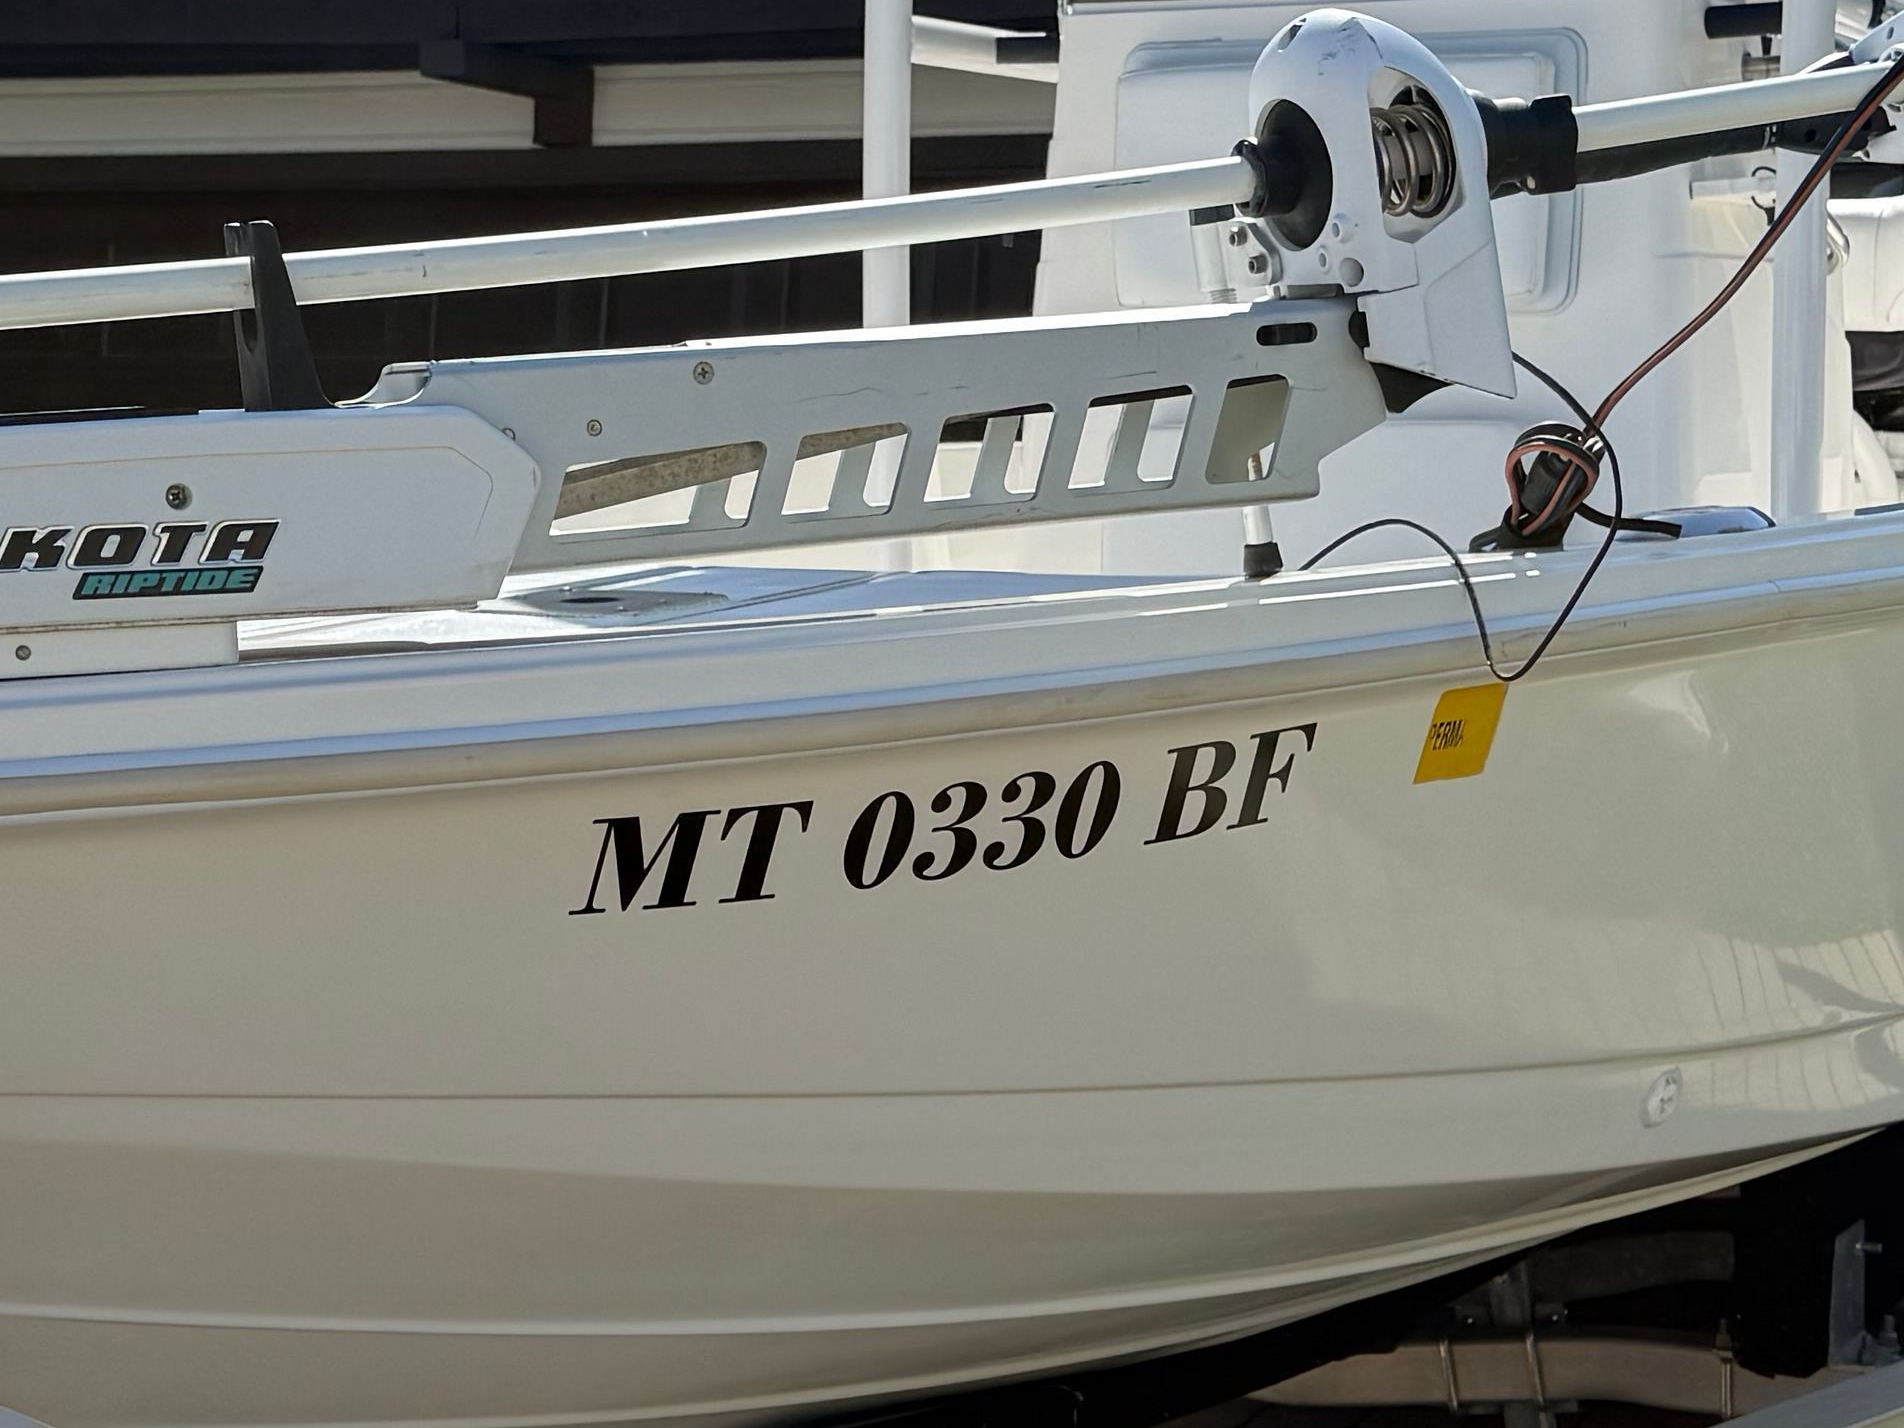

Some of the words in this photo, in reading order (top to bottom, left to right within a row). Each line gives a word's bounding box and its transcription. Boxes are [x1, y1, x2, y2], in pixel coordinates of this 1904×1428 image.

[80, 568, 259, 595] RIPTIDE
[568, 799, 814, 916] MT
[842, 760, 1121, 890] 0330
[1143, 722, 1318, 846] BF
